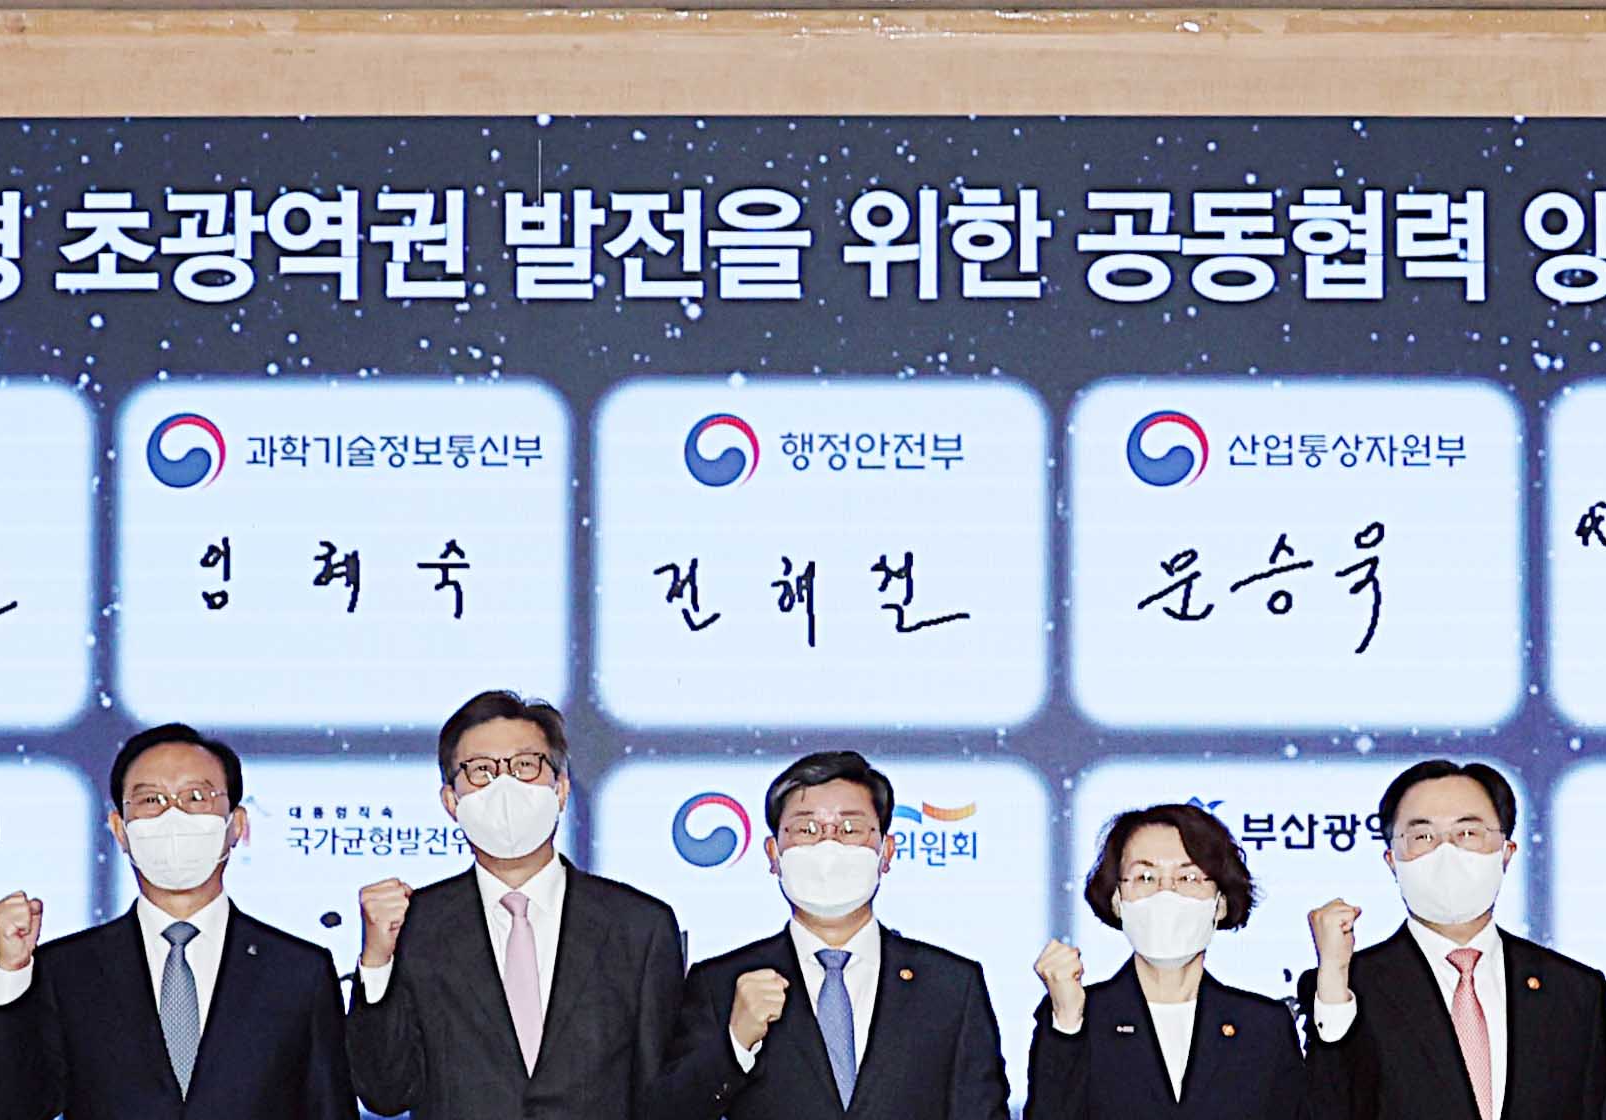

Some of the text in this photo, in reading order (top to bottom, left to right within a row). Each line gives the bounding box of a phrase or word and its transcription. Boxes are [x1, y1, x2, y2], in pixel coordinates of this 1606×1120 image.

[55, 190, 468, 302] 초광역권
[504, 189, 812, 299] 발전을
[843, 190, 1052, 299] 위한
[1077, 190, 1486, 302] 공동협력
[245, 434, 543, 470] 과학기술정보통신부
[780, 431, 965, 472] 행정안전부
[1228, 433, 1467, 469] 산업통상자원부
[894, 830, 977, 867] 위원회
